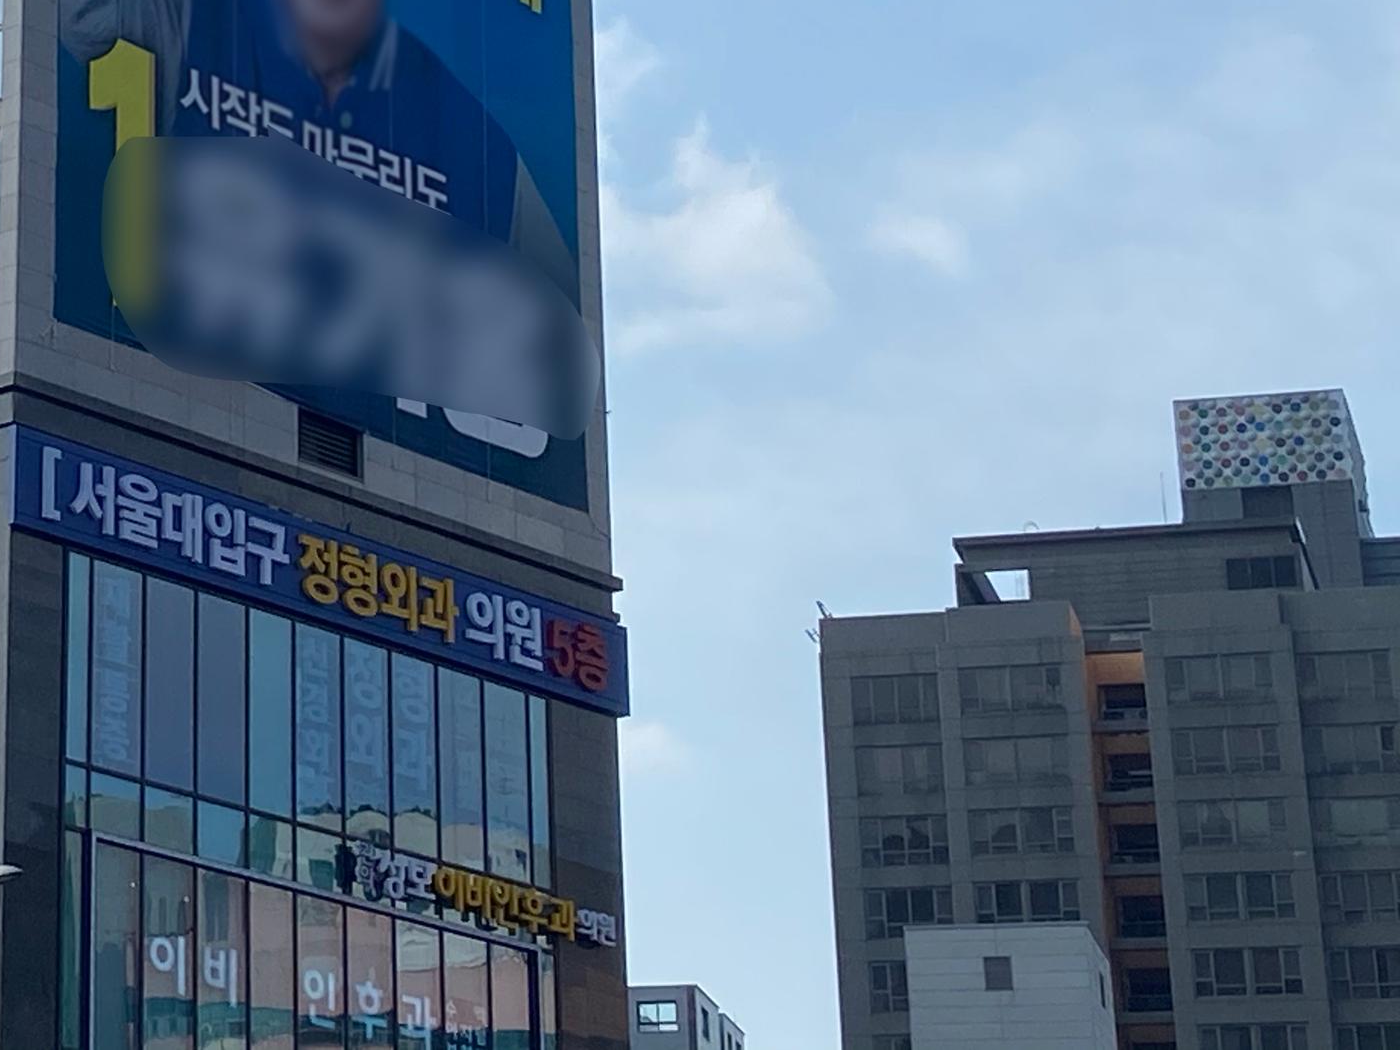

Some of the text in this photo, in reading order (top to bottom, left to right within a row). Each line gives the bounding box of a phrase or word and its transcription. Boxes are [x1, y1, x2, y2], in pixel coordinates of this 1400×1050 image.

[69, 458, 292, 586] 서울대입구
[297, 533, 461, 645] 정형외과
[464, 589, 546, 672] 의원
[548, 618, 609, 693] 5층
[434, 866, 577, 942] 이비인후과
[577, 907, 617, 947] 의원
[149, 935, 438, 1050] 이비 인후과
